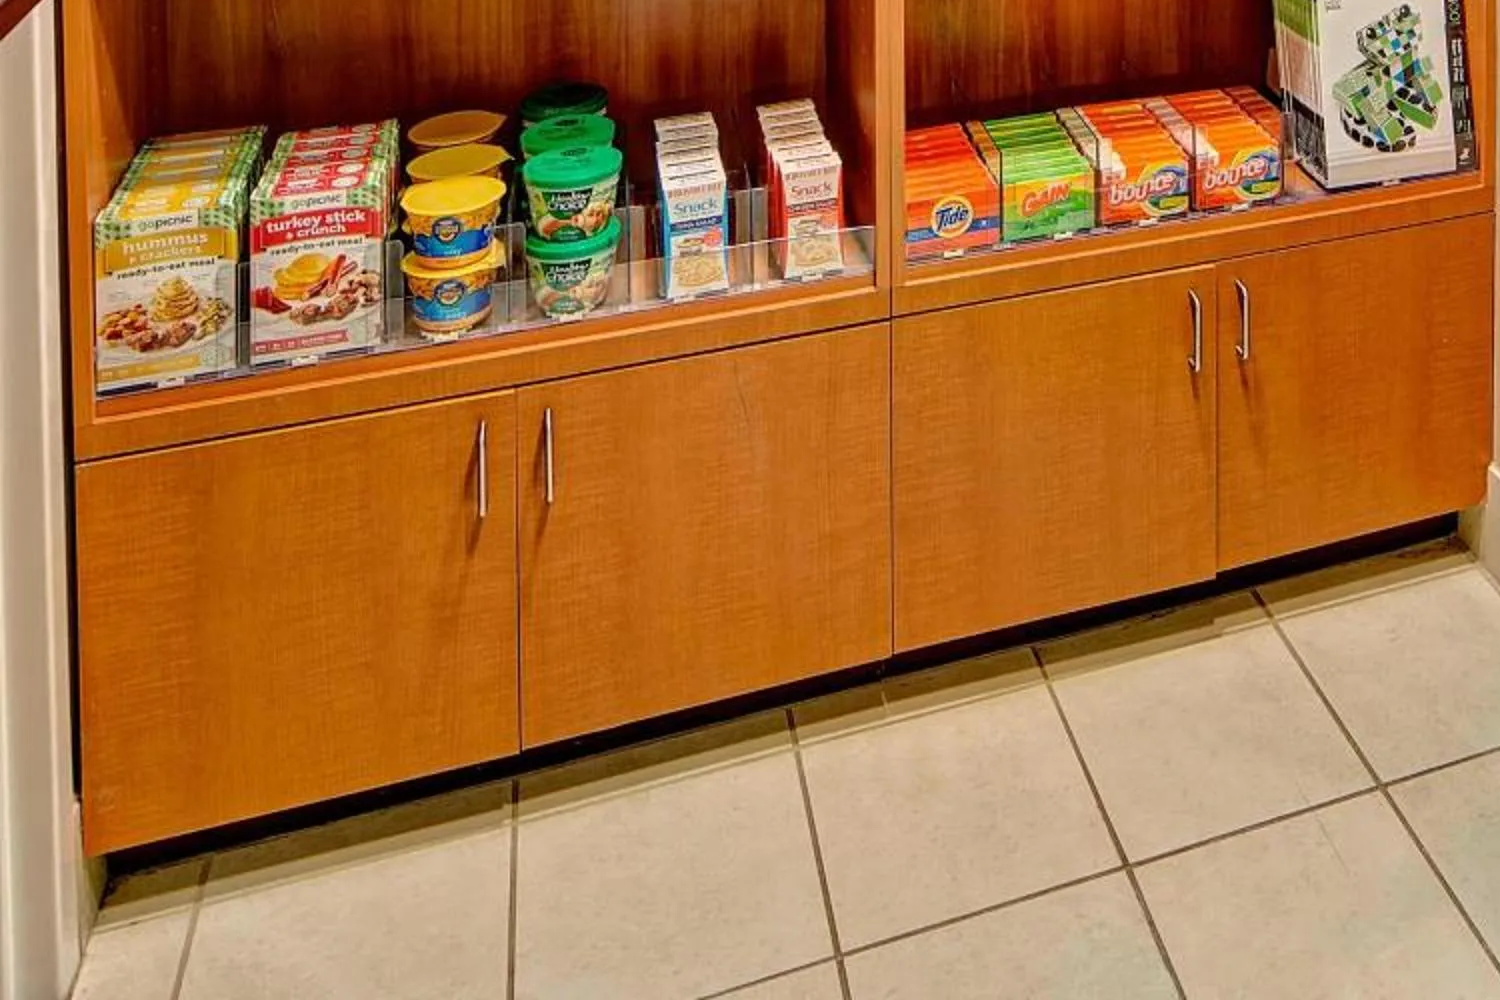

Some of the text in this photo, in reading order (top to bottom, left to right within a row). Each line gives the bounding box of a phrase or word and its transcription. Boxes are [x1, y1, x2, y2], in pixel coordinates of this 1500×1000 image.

[1204, 157, 1268, 190] bounce
[1110, 172, 1177, 204] bounce
[266, 209, 366, 234] turkey stick
[296, 223, 346, 238] crunch
[935, 205, 970, 232] Tide
